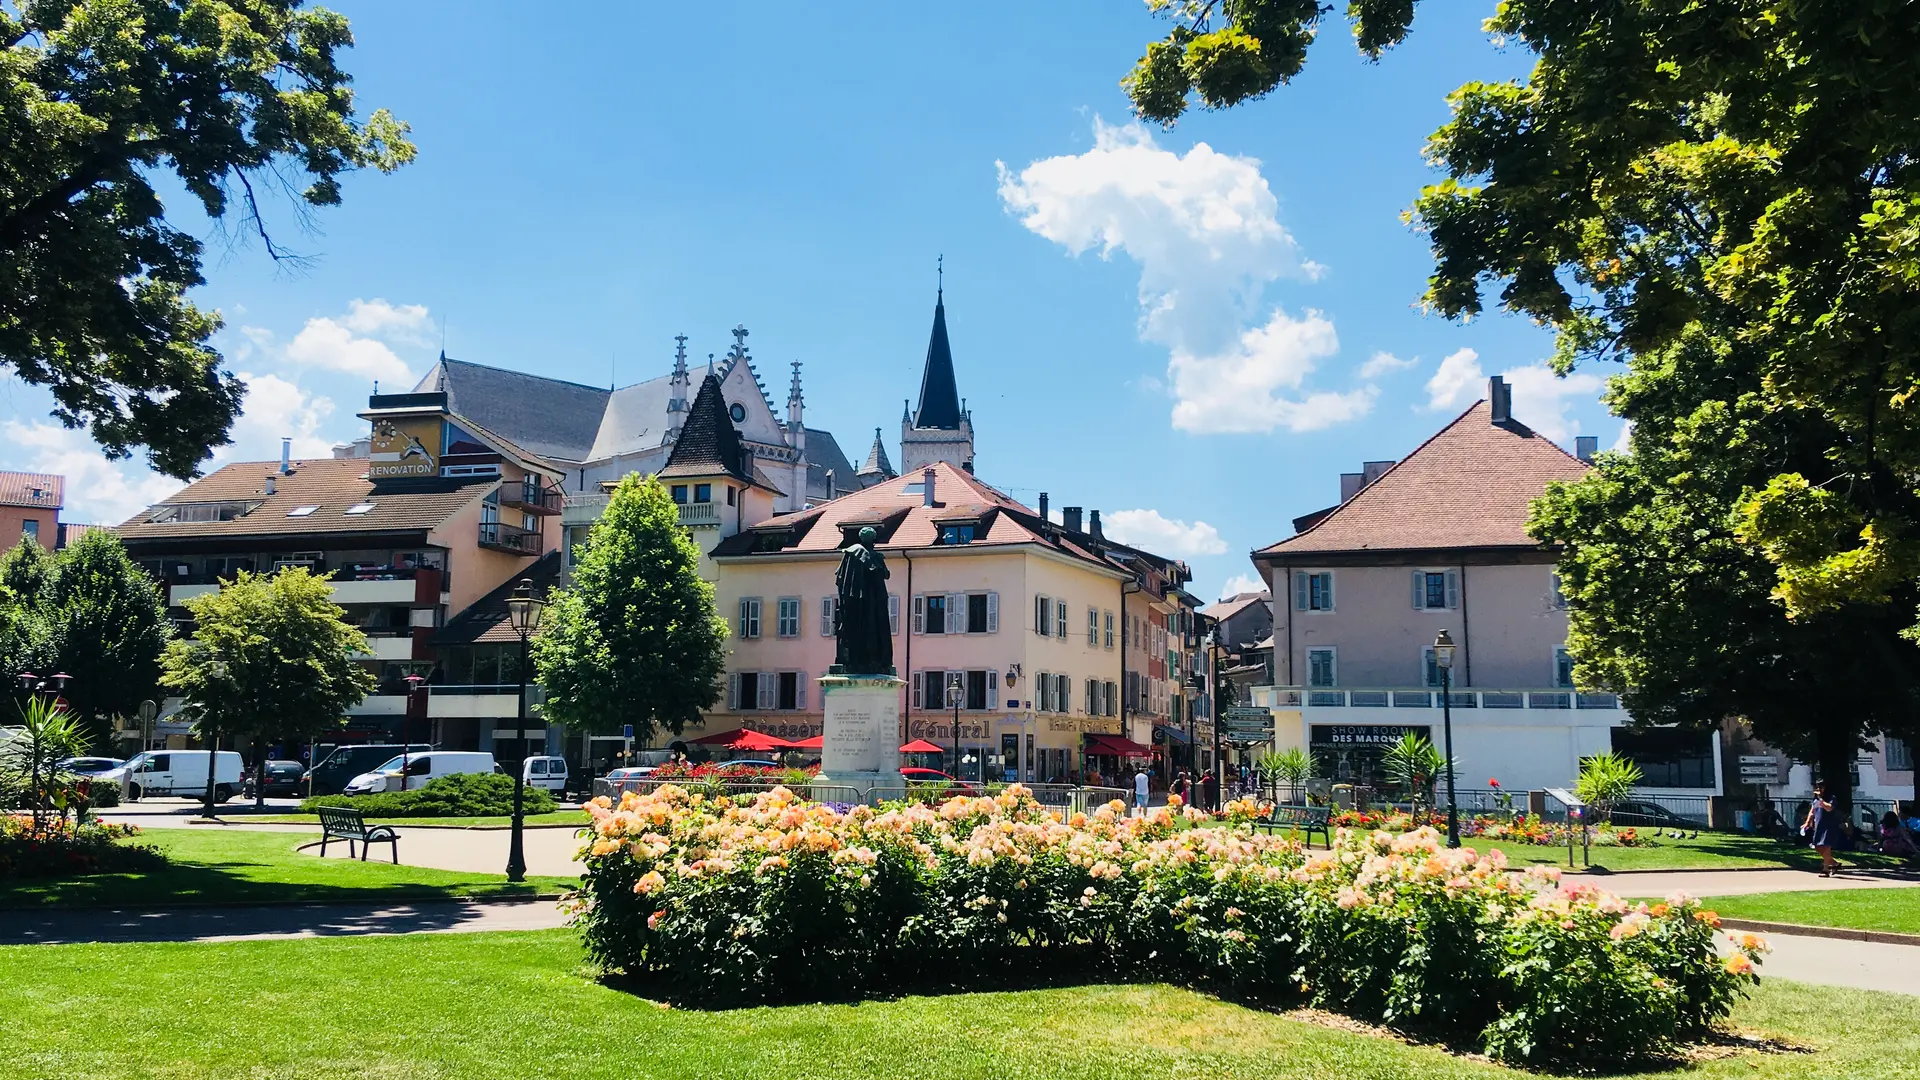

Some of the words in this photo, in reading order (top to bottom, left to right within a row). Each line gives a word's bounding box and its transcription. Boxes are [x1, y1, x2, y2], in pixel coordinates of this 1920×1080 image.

[370, 464, 431, 475] RENOVATION
[741, 719, 824, 738] Brasseri
[910, 719, 991, 738] Général
[1332, 726, 1366, 734] SHOW
